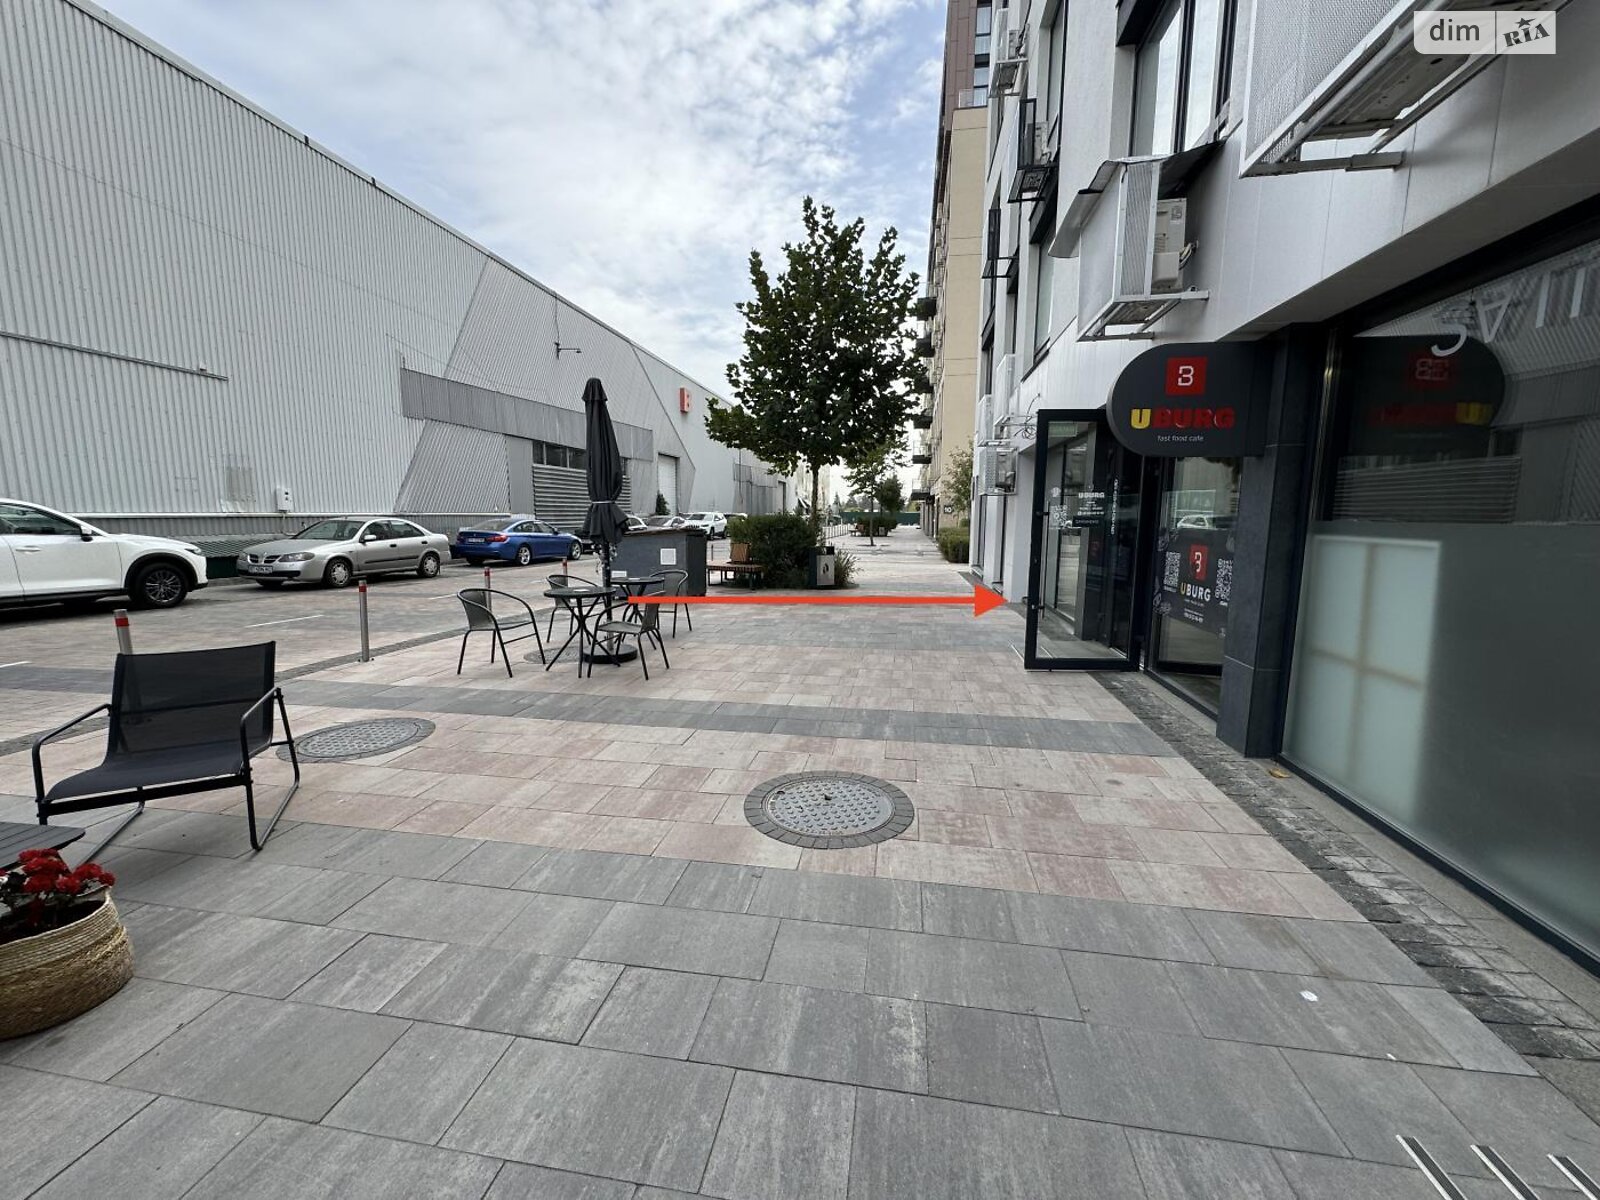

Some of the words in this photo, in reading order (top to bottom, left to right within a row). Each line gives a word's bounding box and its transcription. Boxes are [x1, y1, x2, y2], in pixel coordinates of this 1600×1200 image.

[1131, 407, 1235, 429] UBURG
[1157, 434, 1171, 442] fast
[1172, 434, 1188, 442] food
[1188, 434, 1204, 442] cafe
[1180, 582, 1211, 602] UBURG
